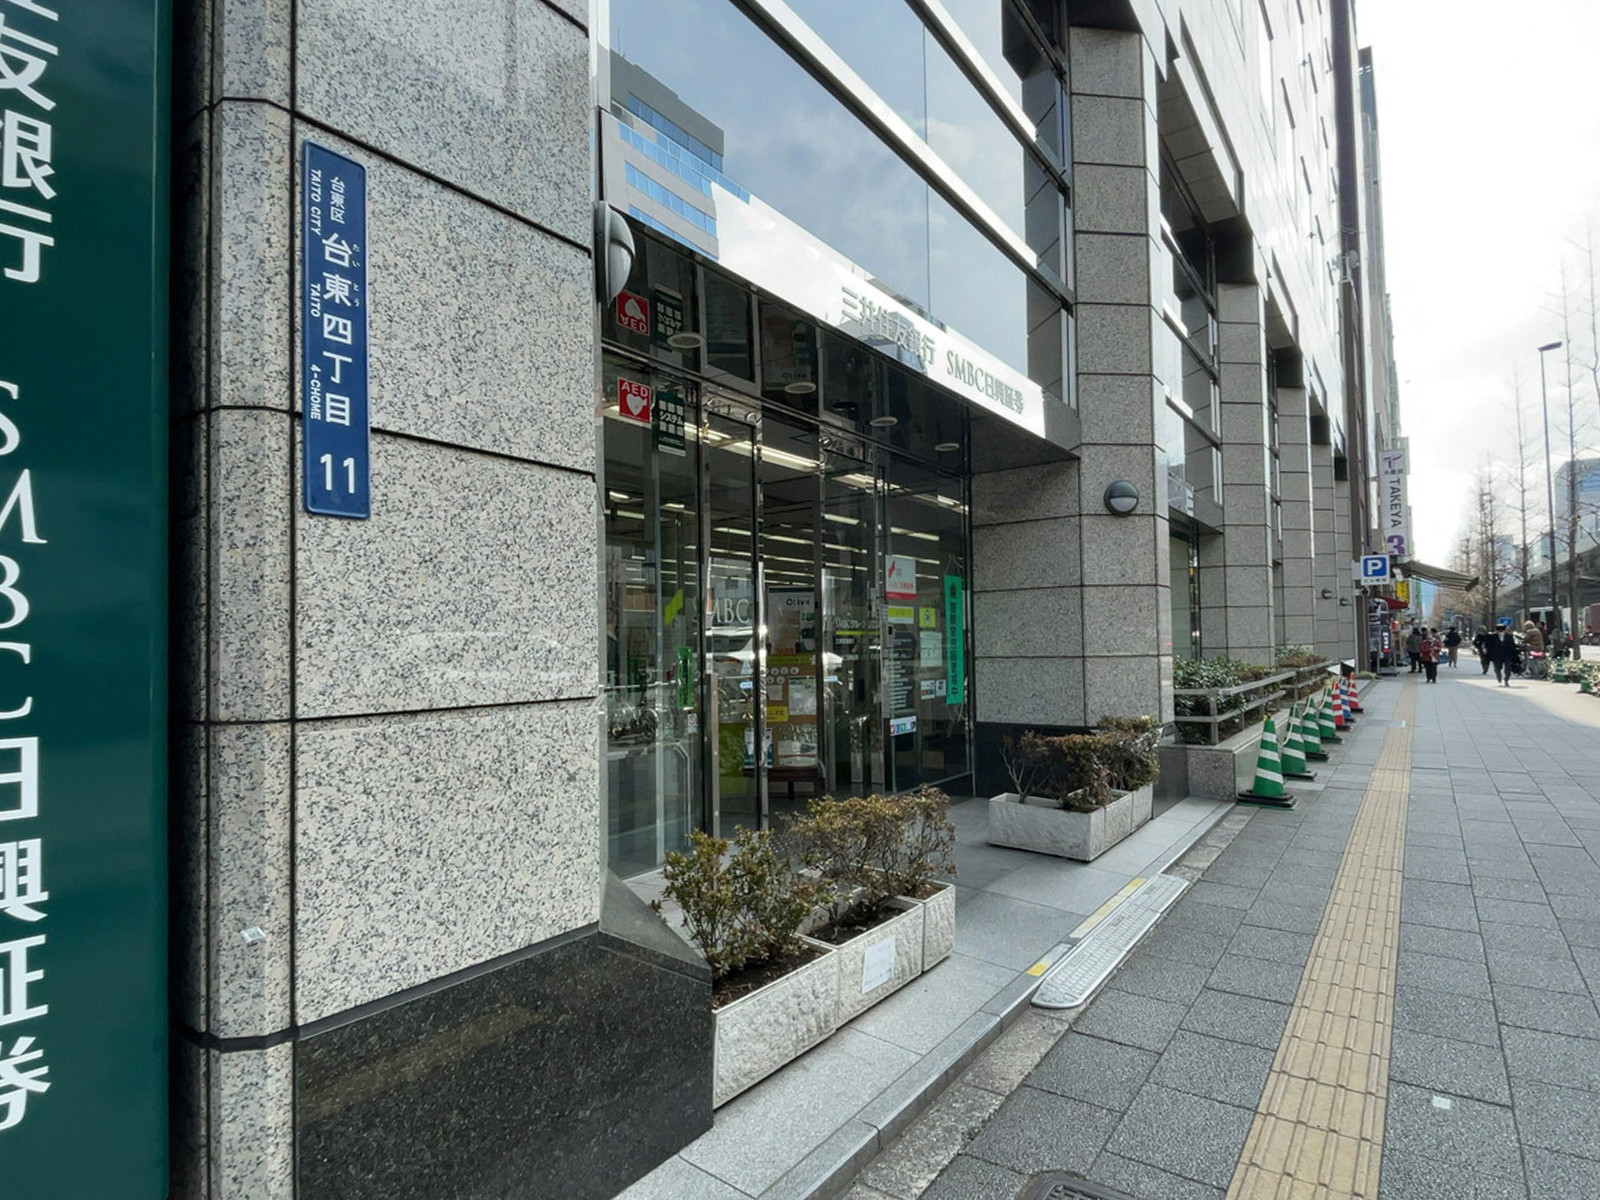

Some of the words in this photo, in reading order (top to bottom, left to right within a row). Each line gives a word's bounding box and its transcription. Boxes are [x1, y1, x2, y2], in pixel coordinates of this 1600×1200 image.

[310, 168, 322, 203] TAITO
[330, 176, 346, 225] 台東区
[310, 207, 322, 236] CITY
[310, 282, 321, 318] TAITO
[321, 232, 353, 427] 台東四丁目
[310, 363, 322, 421] 4-CHOME
[620, 380, 650, 398] AED
[320, 453, 355, 494] 11
[1389, 478, 1403, 528] TAKEYA
[1367, 559, 1383, 575] P
